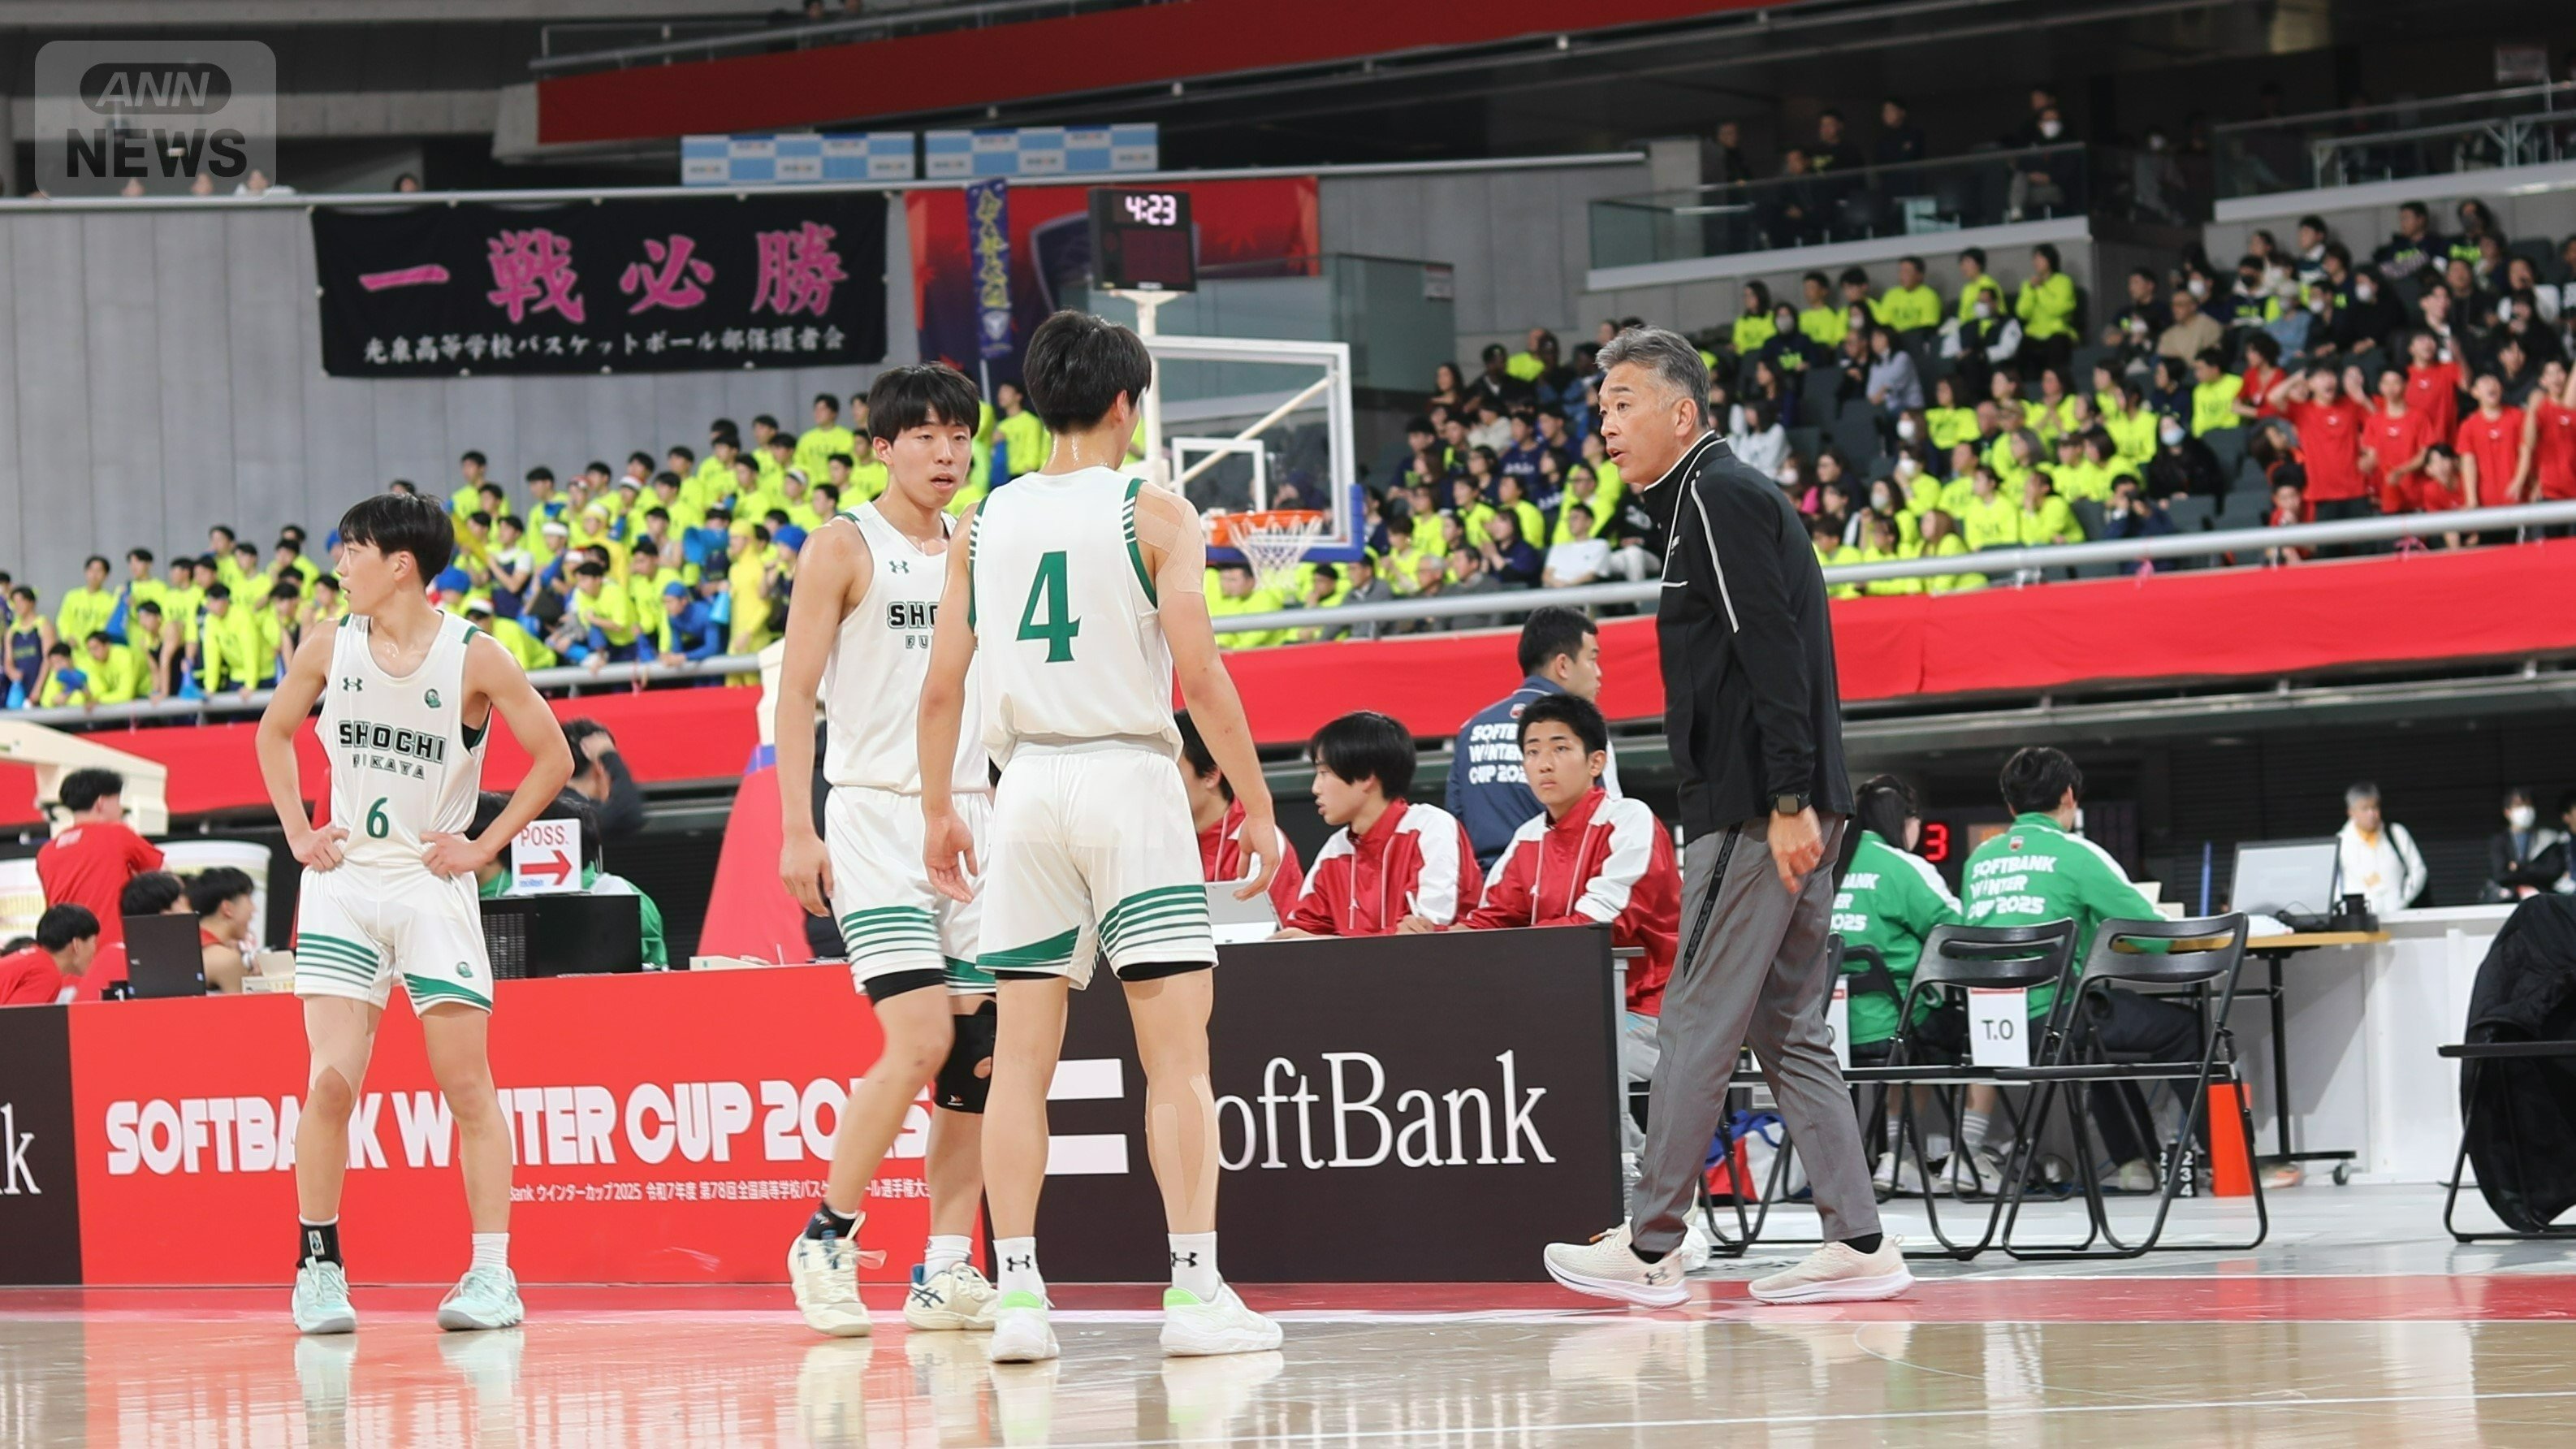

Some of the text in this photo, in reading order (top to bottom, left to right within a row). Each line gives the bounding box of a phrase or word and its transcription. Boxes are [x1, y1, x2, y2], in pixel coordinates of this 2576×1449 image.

[1125, 194, 1177, 226] 4:23
[359, 221, 849, 324] 一戦必勝
[1016, 550, 1082, 663] 4
[339, 720, 447, 764] SHOCHI
[1468, 764, 1529, 785] CUP 202
[366, 797, 389, 838] 6
[1925, 823, 1948, 861] 3
[1972, 854, 2058, 879] SOFTBANK
[1969, 874, 2029, 899] WINTER
[1995, 895, 2046, 915] 2025
[106, 1092, 390, 1175] SOFTBAK
[625, 1082, 754, 1165] CUP
[759, 1077, 932, 1161] 205
[1213, 1049, 1558, 1171] oftBank
[0, 1101, 42, 1195] k
[646, 1180, 698, 1201] 令和7年度
